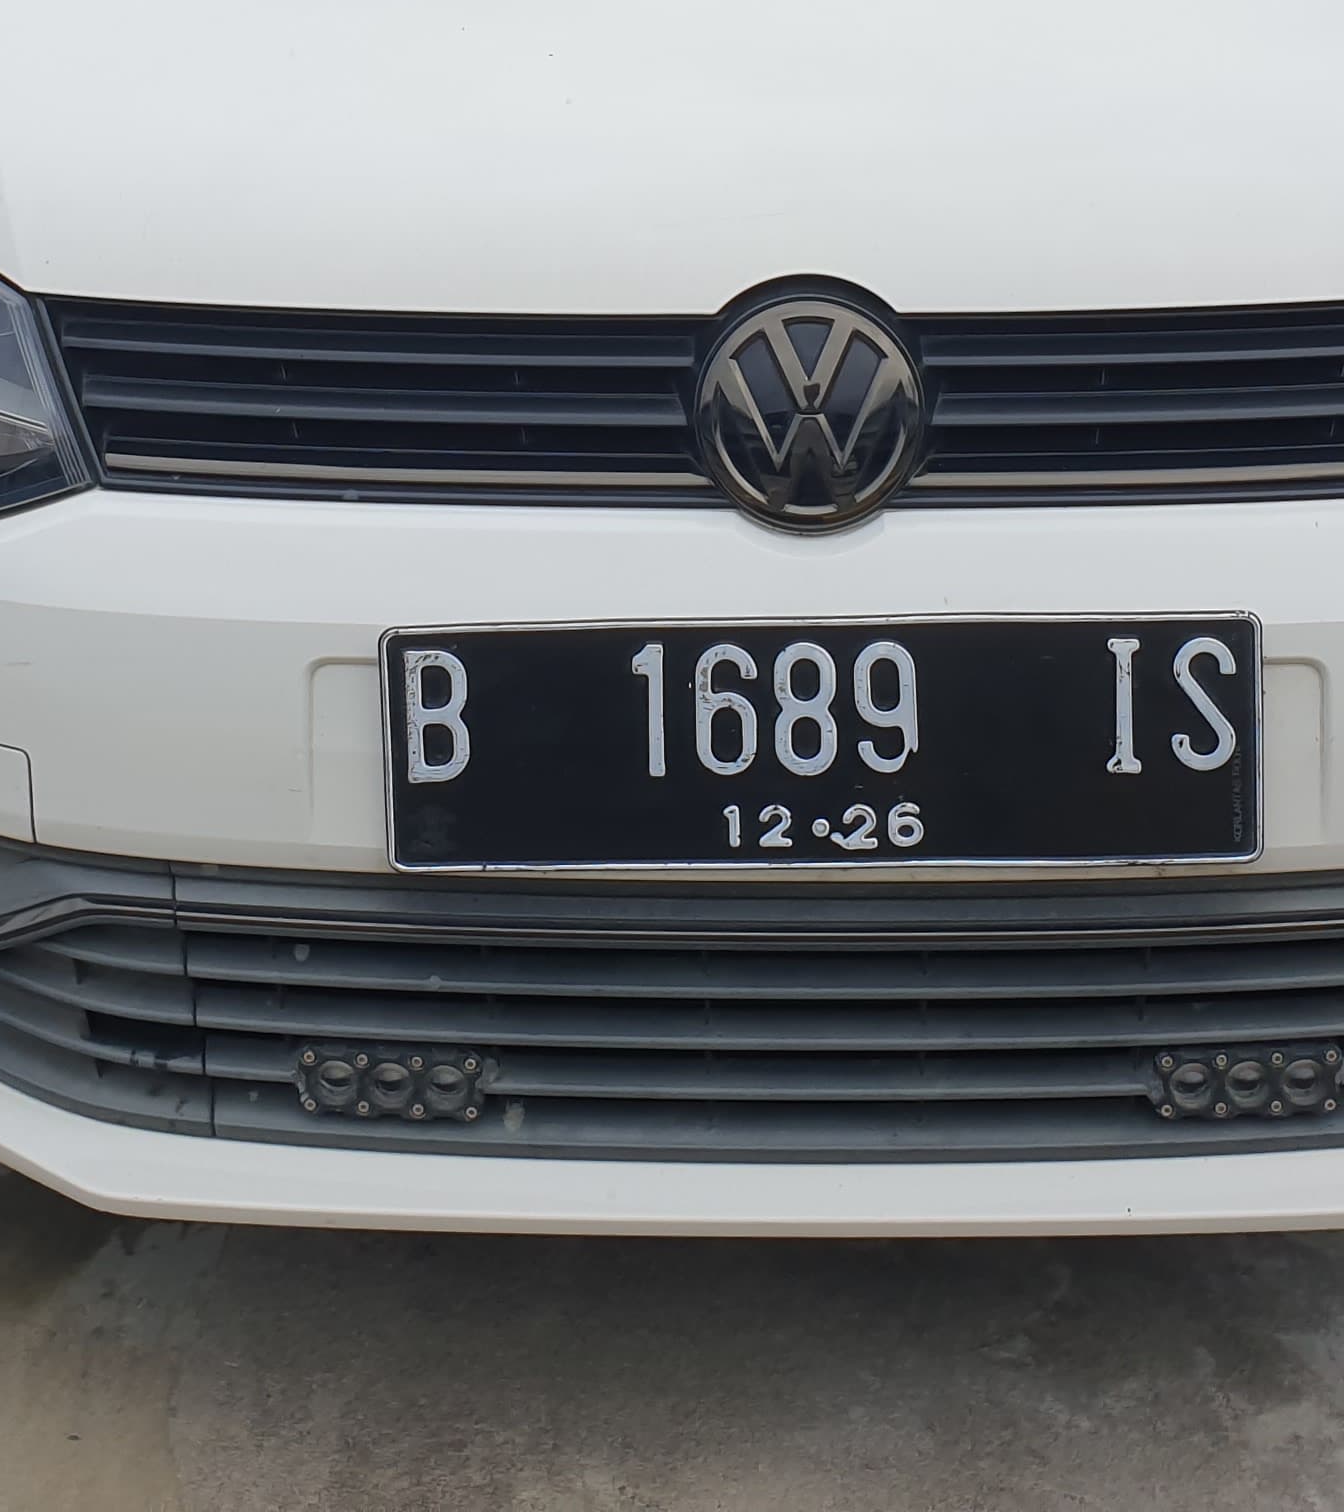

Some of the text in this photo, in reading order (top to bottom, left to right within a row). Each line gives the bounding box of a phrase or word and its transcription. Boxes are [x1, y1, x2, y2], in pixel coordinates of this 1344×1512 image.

[403, 637, 1237, 783] B 1689 IS
